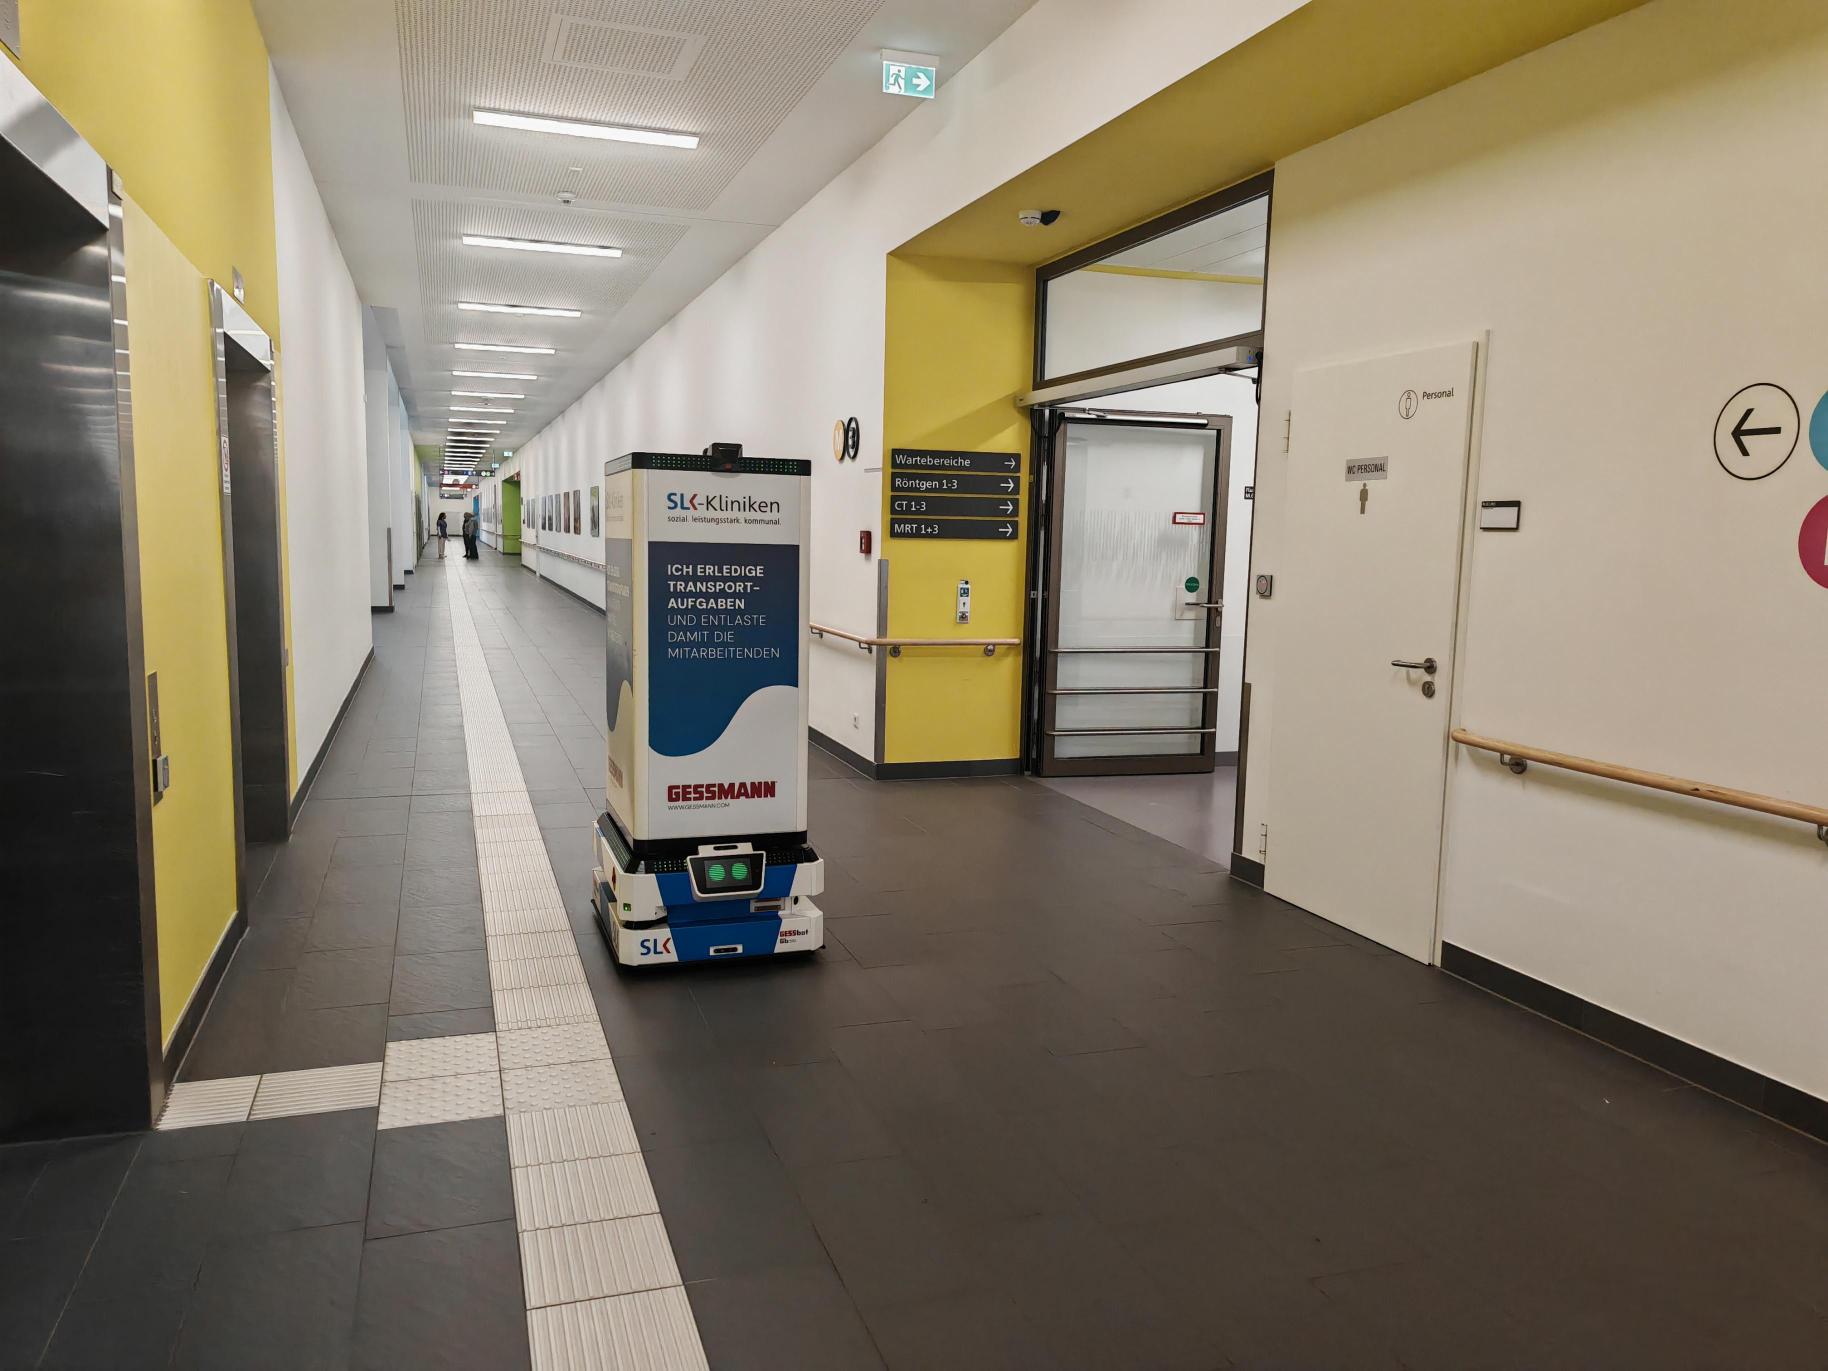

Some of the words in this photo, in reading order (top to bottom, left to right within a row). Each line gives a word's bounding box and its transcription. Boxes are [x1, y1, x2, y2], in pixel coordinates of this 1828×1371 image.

[1422, 387, 1454, 400] Personal
[895, 454, 971, 467] Wartebereiche
[1347, 465, 1356, 475] WC
[1357, 462, 1386, 474] PERSONAL
[895, 477, 939, 491] Röntgen
[942, 479, 958, 489] 1-3
[667, 492, 780, 513] SLK-Kliniken
[894, 501, 908, 511] CT
[911, 501, 926, 511] 1-3
[667, 514, 689, 523] sozial.
[691, 515, 742, 526] leistungsstark.
[744, 516, 781, 526] kommunal.
[894, 523, 917, 534] MRT
[920, 524, 939, 535] 1+3
[667, 564, 693, 576] ICH
[697, 564, 764, 577] ERLEDIGE
[667, 581, 760, 593] TRANSPORT-
[667, 598, 745, 610] AUFGABEN
[667, 614, 697, 626] UND
[701, 614, 767, 626] ENTLASTE
[667, 631, 710, 643] DAMIT
[714, 631, 735, 643] DIE
[667, 647, 780, 659] MITARBEITENDEN
[667, 781, 776, 803] GESSMANN
[667, 802, 730, 811] WWW.GESSMANN.COM
[640, 937, 672, 956] SLK
